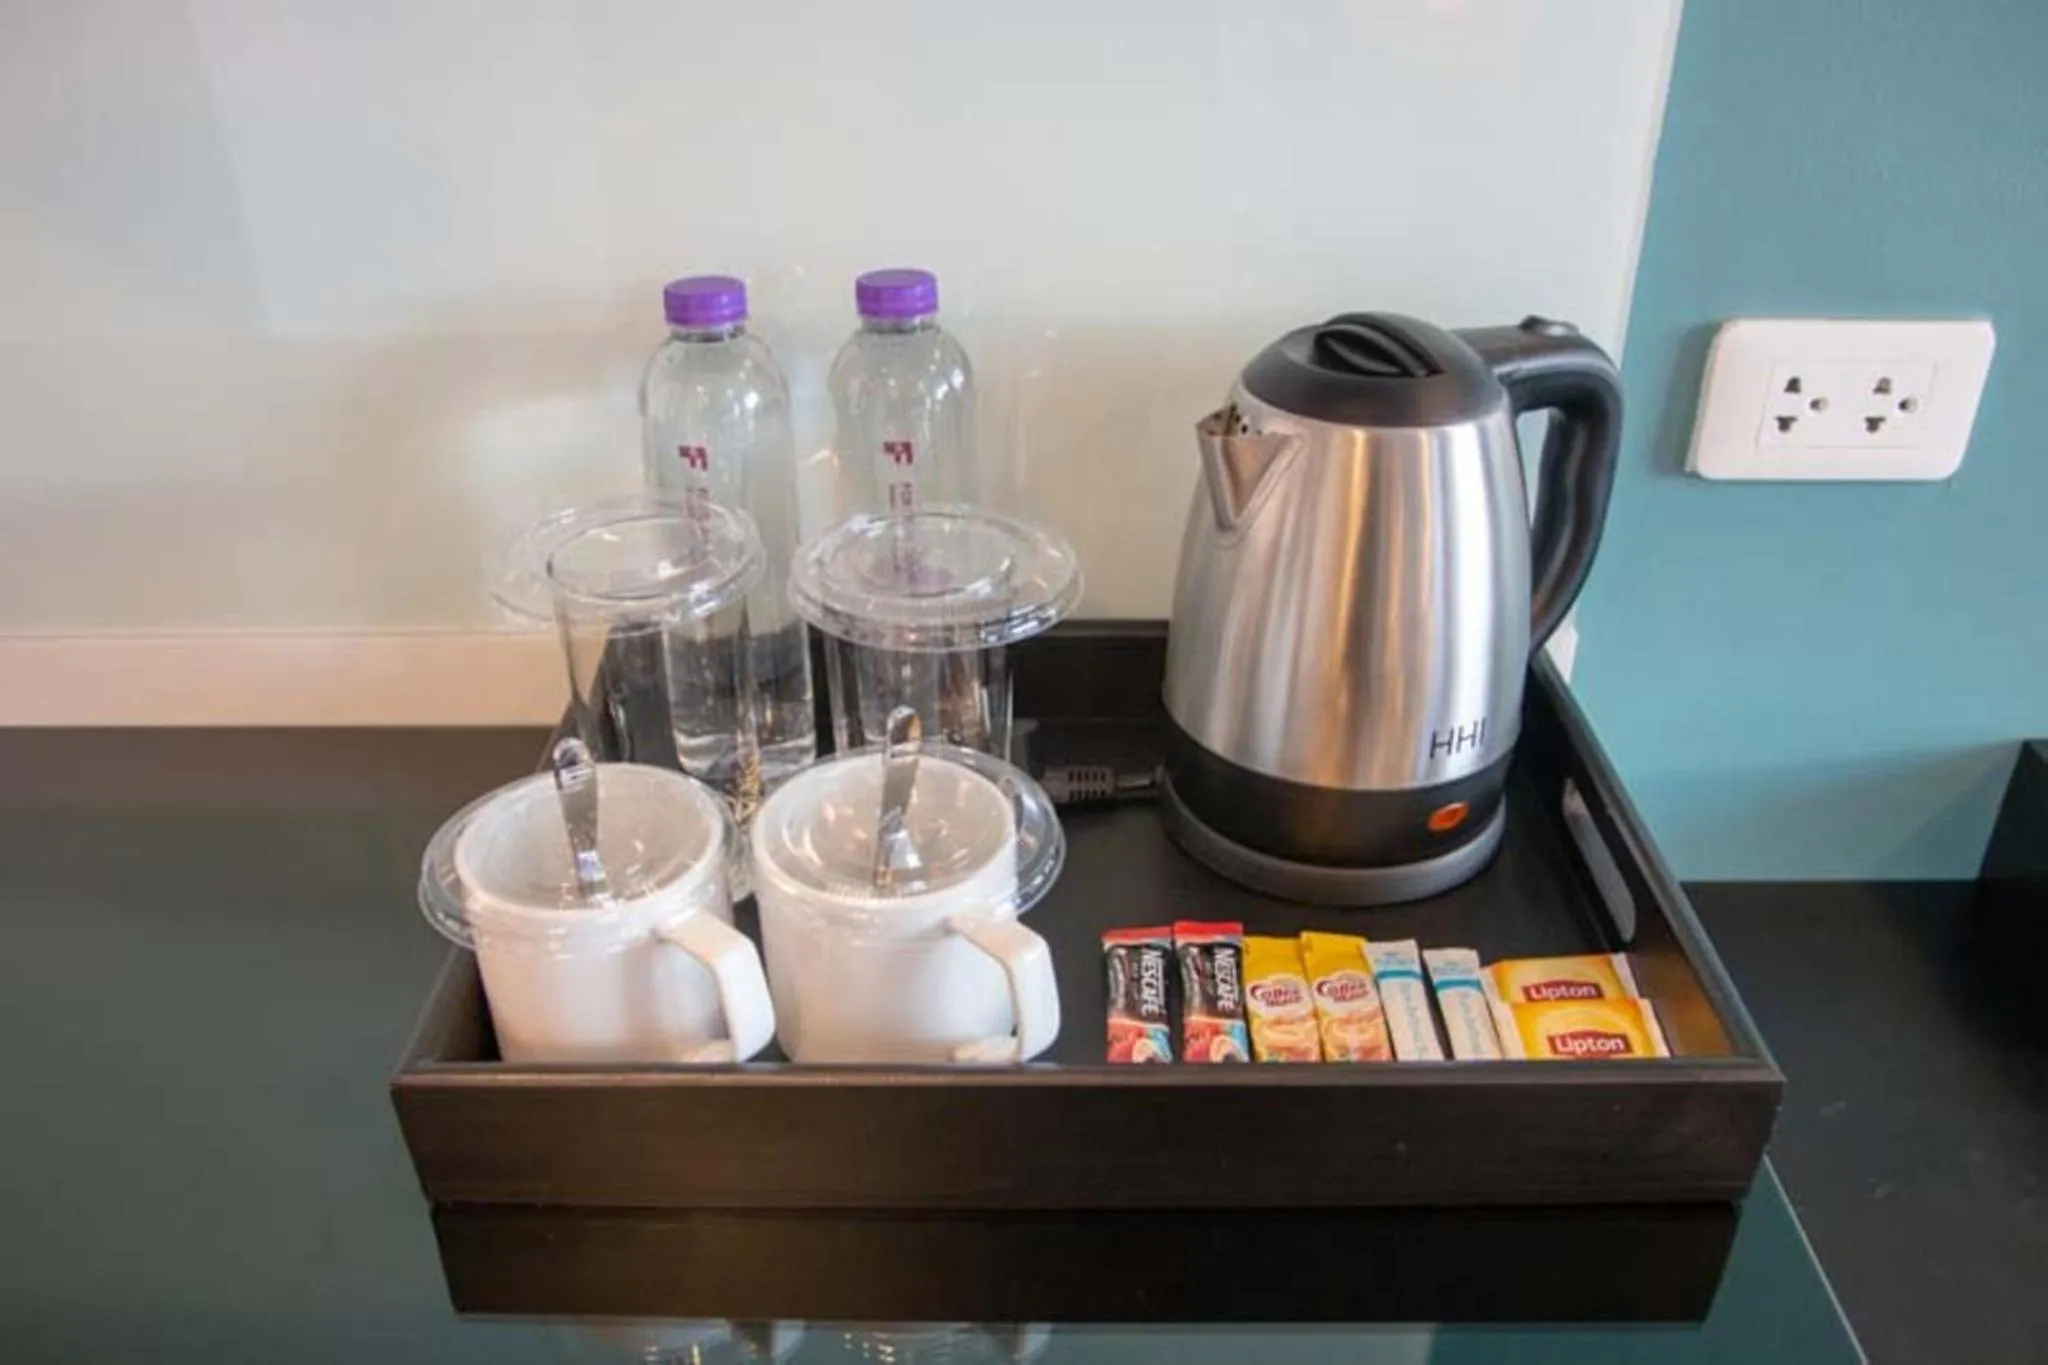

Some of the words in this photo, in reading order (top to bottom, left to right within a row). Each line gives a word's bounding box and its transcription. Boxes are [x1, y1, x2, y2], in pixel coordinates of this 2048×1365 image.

[1429, 716, 1487, 760] HHI
[1529, 984, 1597, 1001] Lipton
[1555, 1037, 1625, 1054] Lipton
